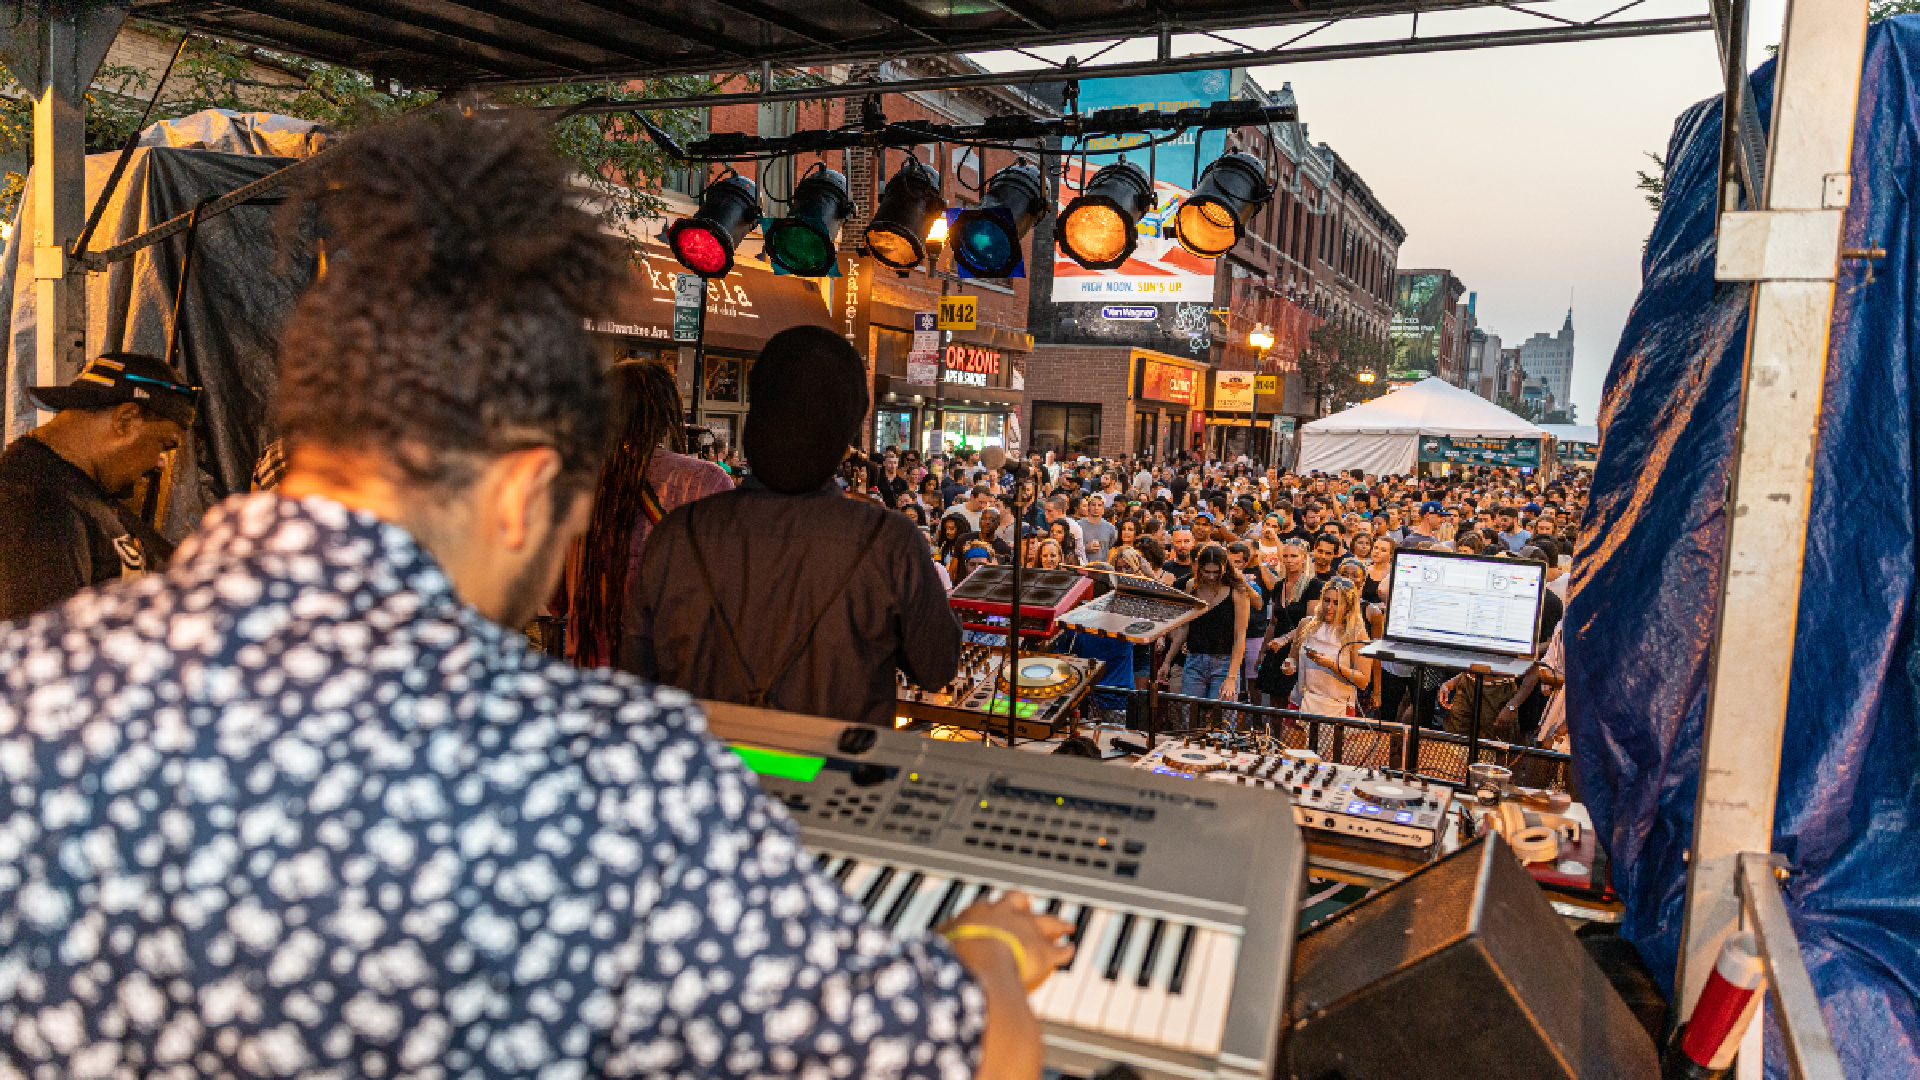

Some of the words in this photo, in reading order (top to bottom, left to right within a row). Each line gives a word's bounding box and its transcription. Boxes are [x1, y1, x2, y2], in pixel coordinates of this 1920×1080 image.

[641, 257, 754, 307] kaela
[1081, 282, 1103, 292] HIGH
[1137, 281, 1166, 293] SUN'S
[845, 258, 860, 346] kanel
[939, 303, 975, 322] M42
[1123, 307, 1156, 319] Wagner
[946, 345, 965, 371] OR
[965, 348, 1001, 375] ZONE
